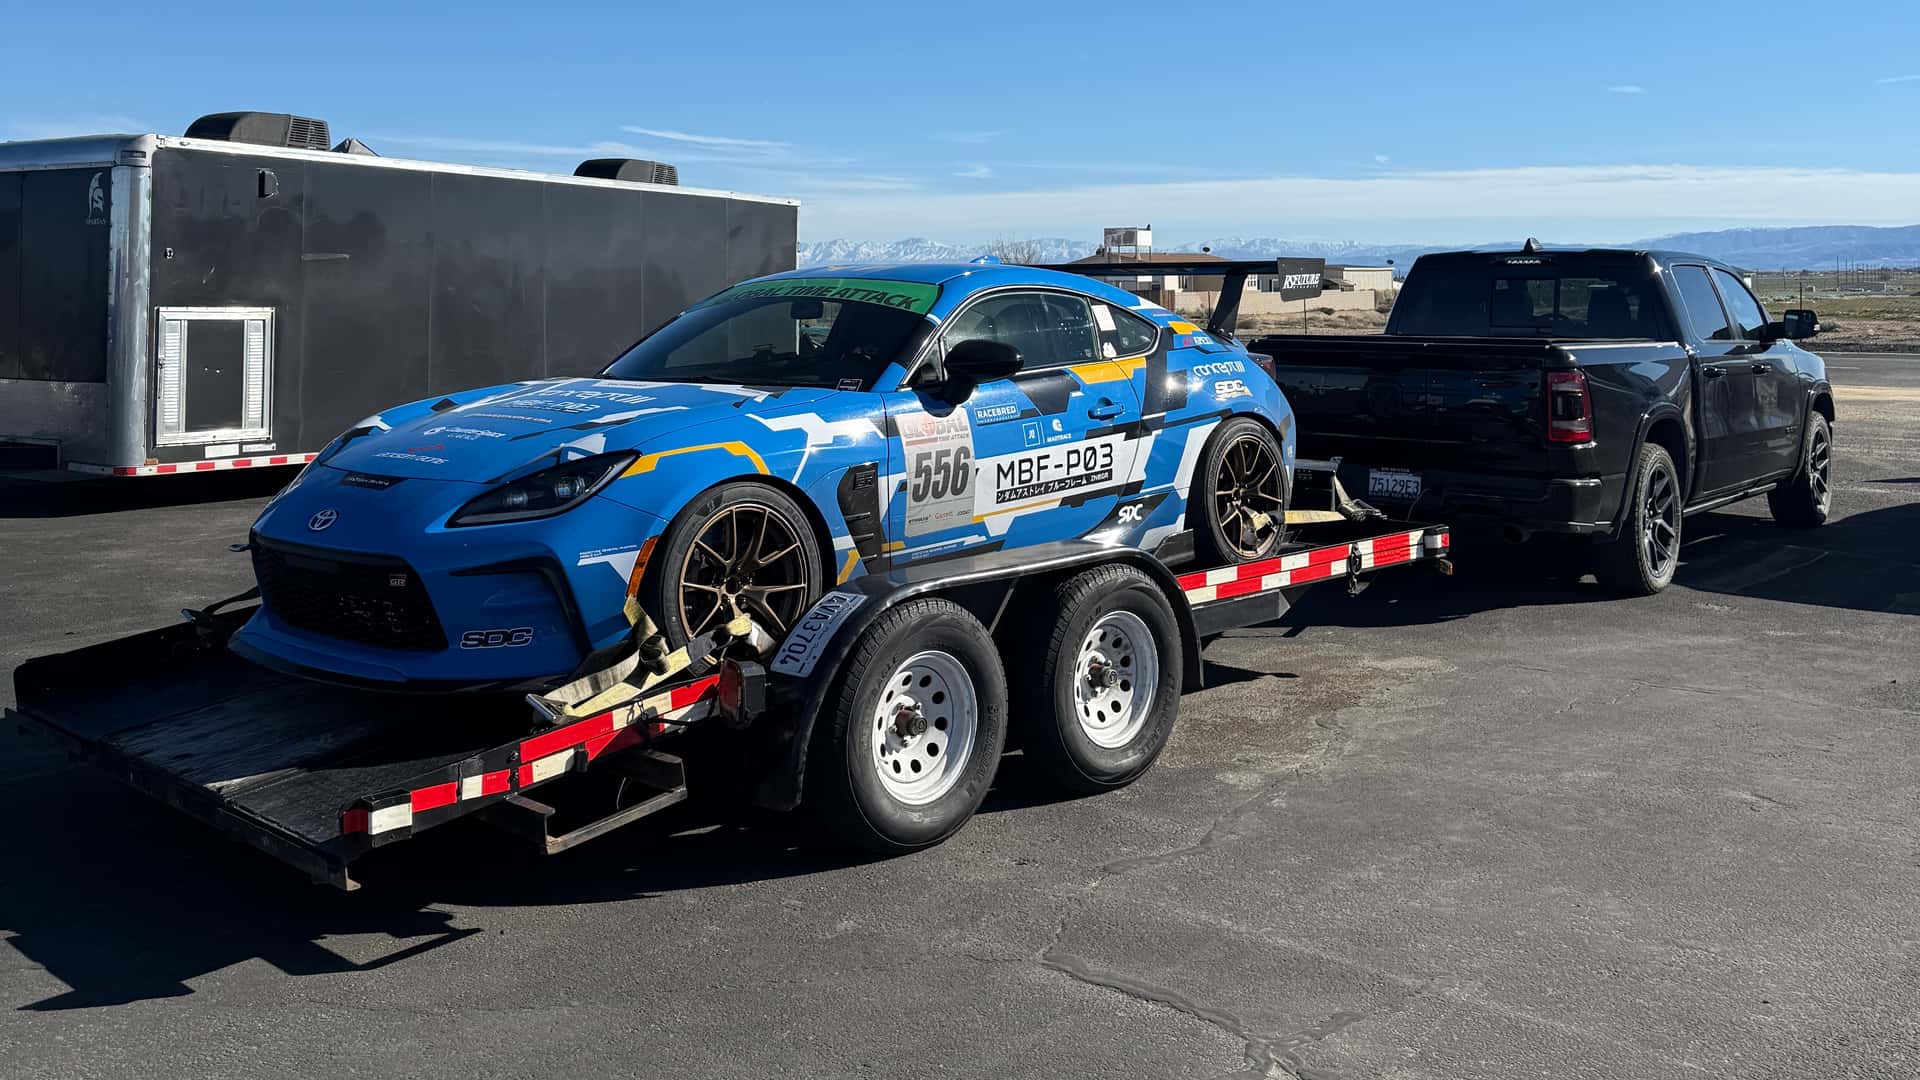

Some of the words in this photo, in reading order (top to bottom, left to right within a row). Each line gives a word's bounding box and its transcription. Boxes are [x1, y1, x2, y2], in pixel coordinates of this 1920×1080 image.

[785, 285, 835, 298] TIME
[830, 287, 921, 309] ATTACK
[1215, 380, 1244, 395] SDC
[977, 406, 1017, 418] RACEBRED
[912, 446, 971, 503] 556
[996, 443, 1114, 490] MBF-P03
[1118, 503, 1144, 525] SDC
[460, 626, 534, 650] SDC
